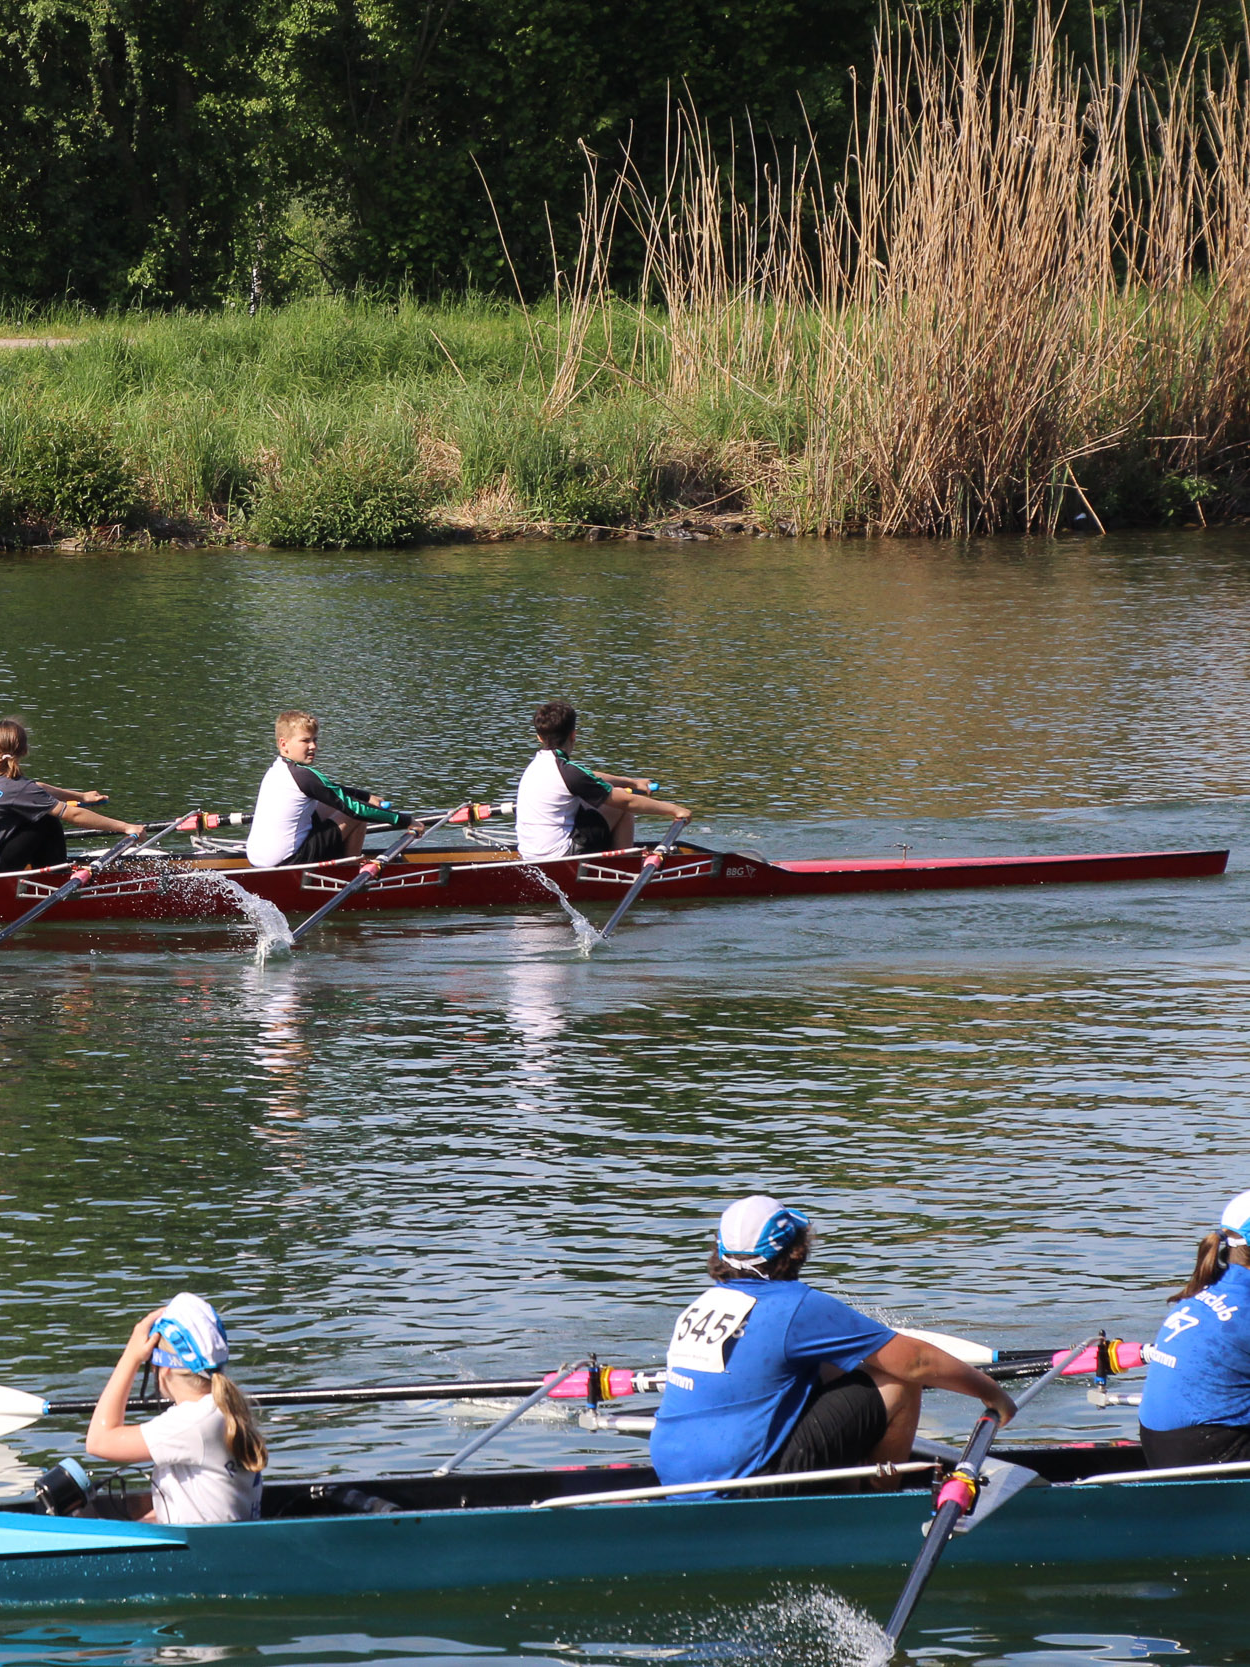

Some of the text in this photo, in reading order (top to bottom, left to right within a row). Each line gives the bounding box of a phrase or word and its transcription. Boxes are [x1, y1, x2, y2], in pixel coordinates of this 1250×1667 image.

[726, 867, 744, 876] BBG
[1195, 1285, 1238, 1322] erclub
[677, 1307, 736, 1345] 545
